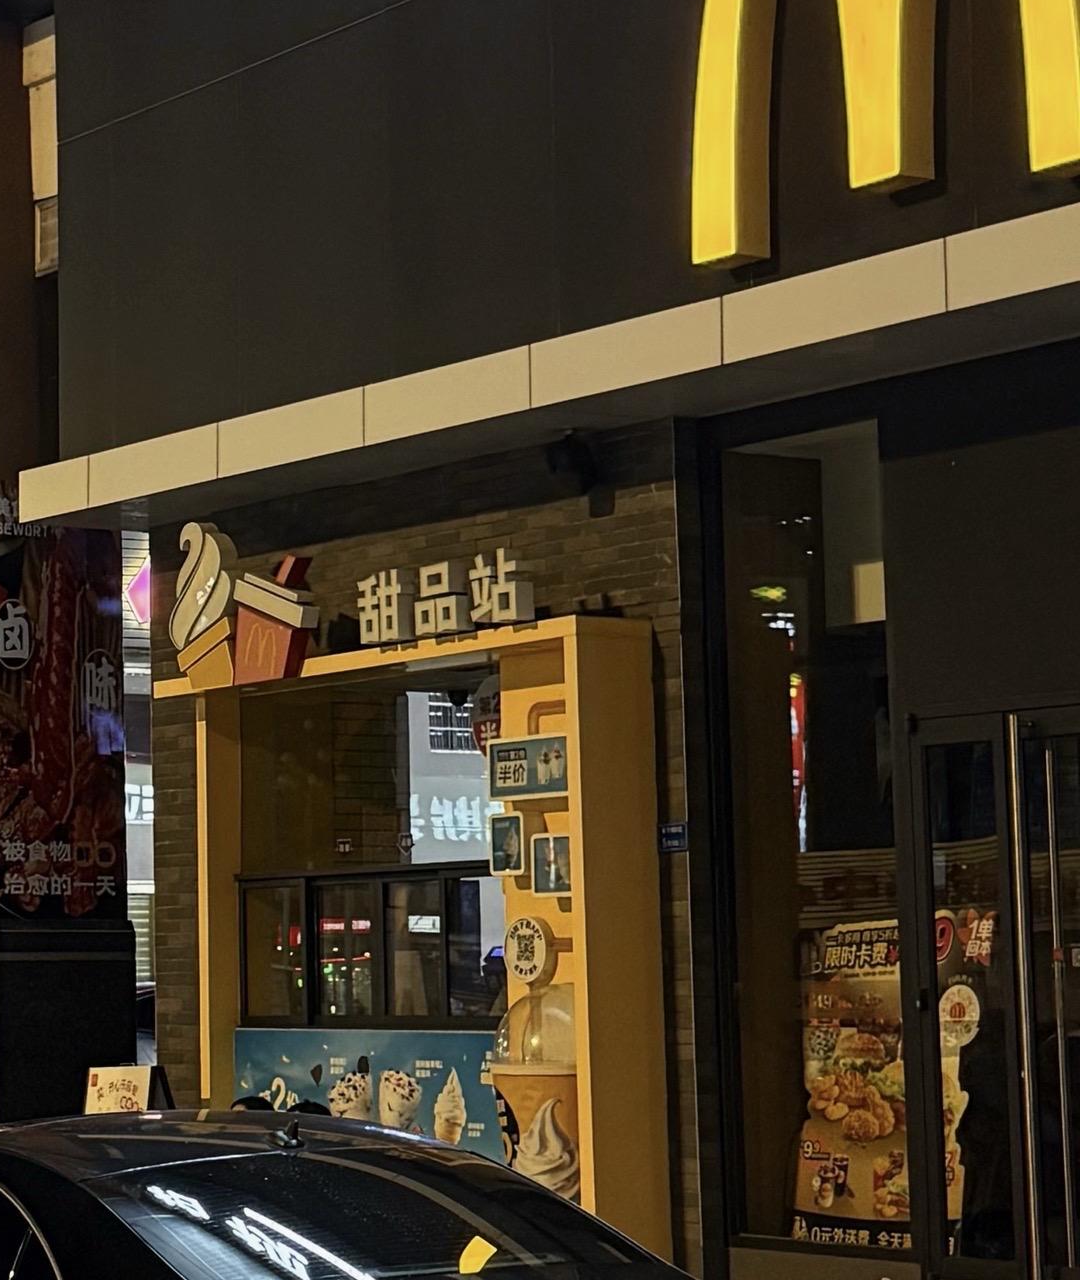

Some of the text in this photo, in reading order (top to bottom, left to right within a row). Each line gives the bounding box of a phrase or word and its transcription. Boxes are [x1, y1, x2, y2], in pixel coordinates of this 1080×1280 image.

[357, 547, 518, 645] 甜品站
[498, 764, 526, 784] 半价
[0, 839, 72, 862] 被食物
[4, 873, 116, 896] 治愈的一天
